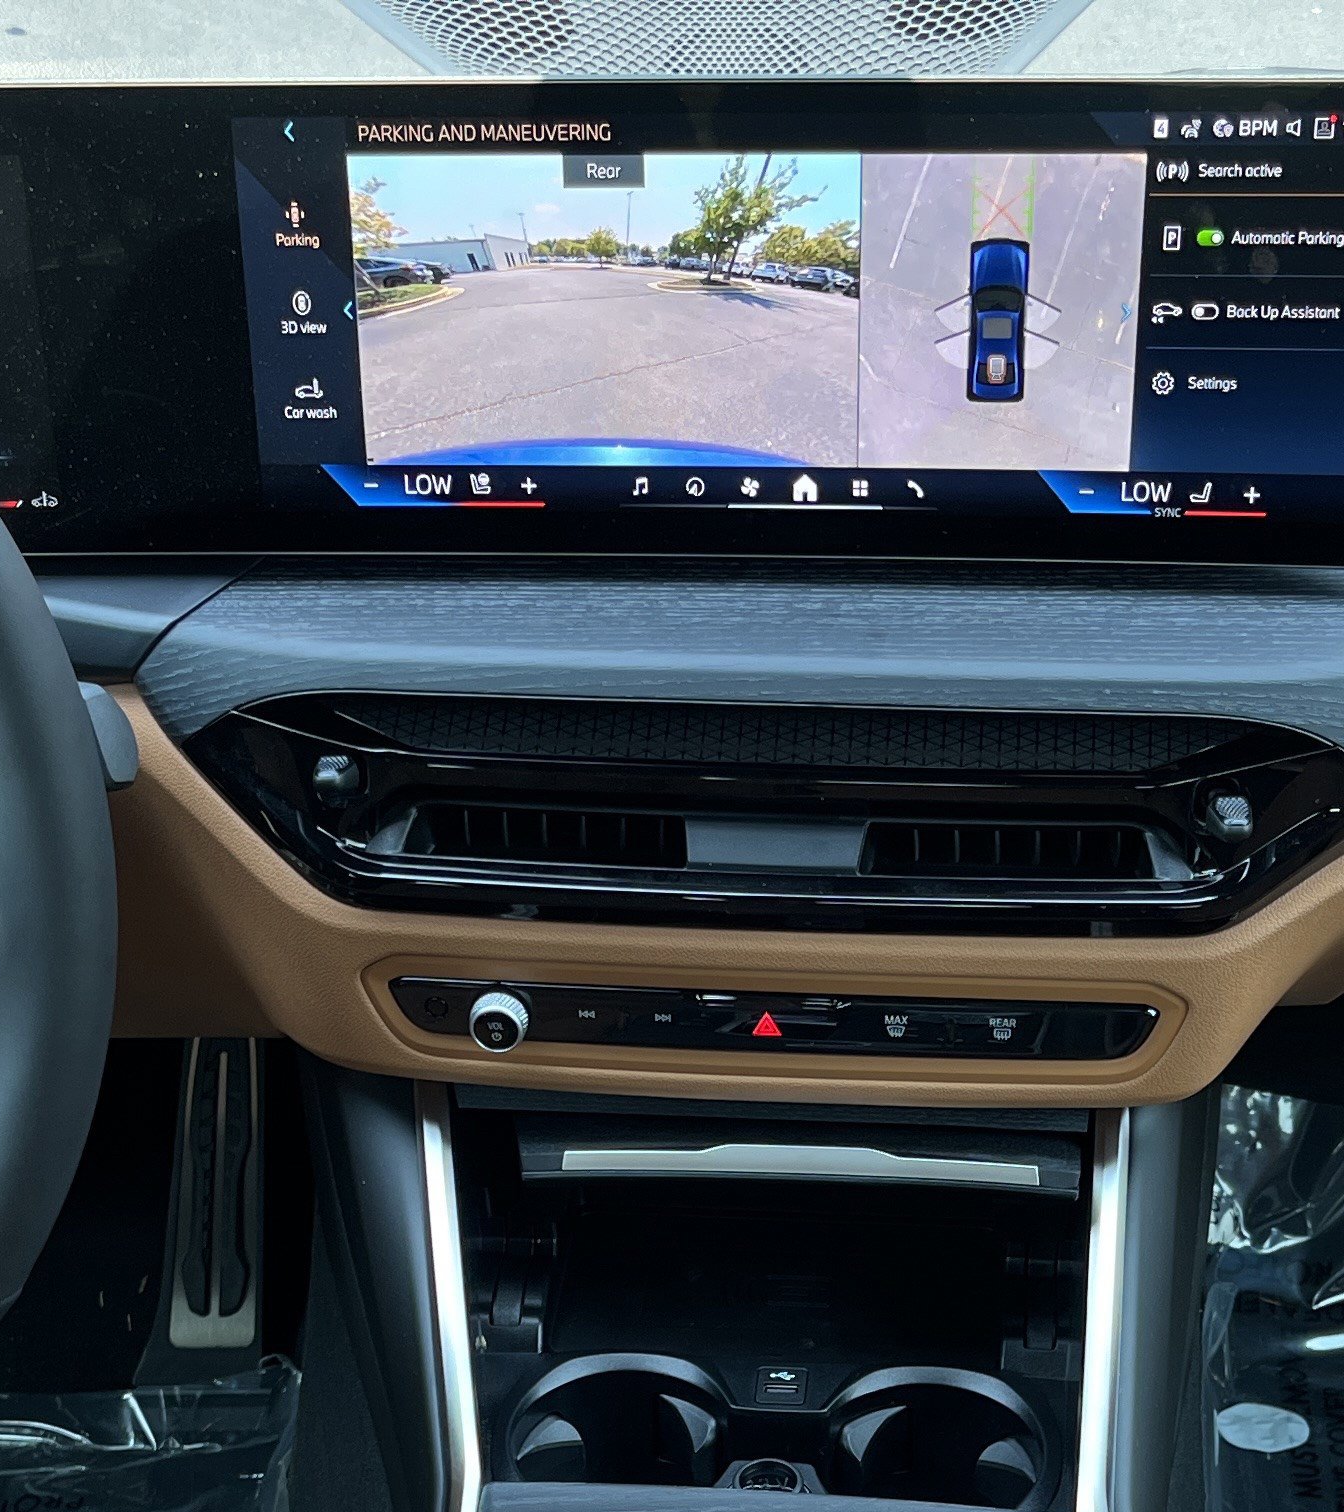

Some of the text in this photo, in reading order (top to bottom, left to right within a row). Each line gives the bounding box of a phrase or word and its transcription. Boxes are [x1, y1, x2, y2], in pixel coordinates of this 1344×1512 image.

[357, 122, 611, 143] PARKING AND MANEUVERING
[1239, 120, 1278, 137] BPM
[586, 163, 622, 180] Rear
[1197, 163, 1283, 178] Search active
[275, 232, 320, 249] Parking
[1231, 231, 1295, 246] Automatic
[1226, 304, 1341, 323] Back Up Assistant
[281, 320, 327, 335] 3D view
[1187, 376, 1238, 393] Settings
[284, 405, 338, 419] Car wash
[403, 473, 452, 495] LOW
[1120, 482, 1172, 504] LOW
[1154, 507, 1182, 519] SYNC
[884, 1015, 909, 1025] MAX
[988, 1018, 1017, 1028] REAR
